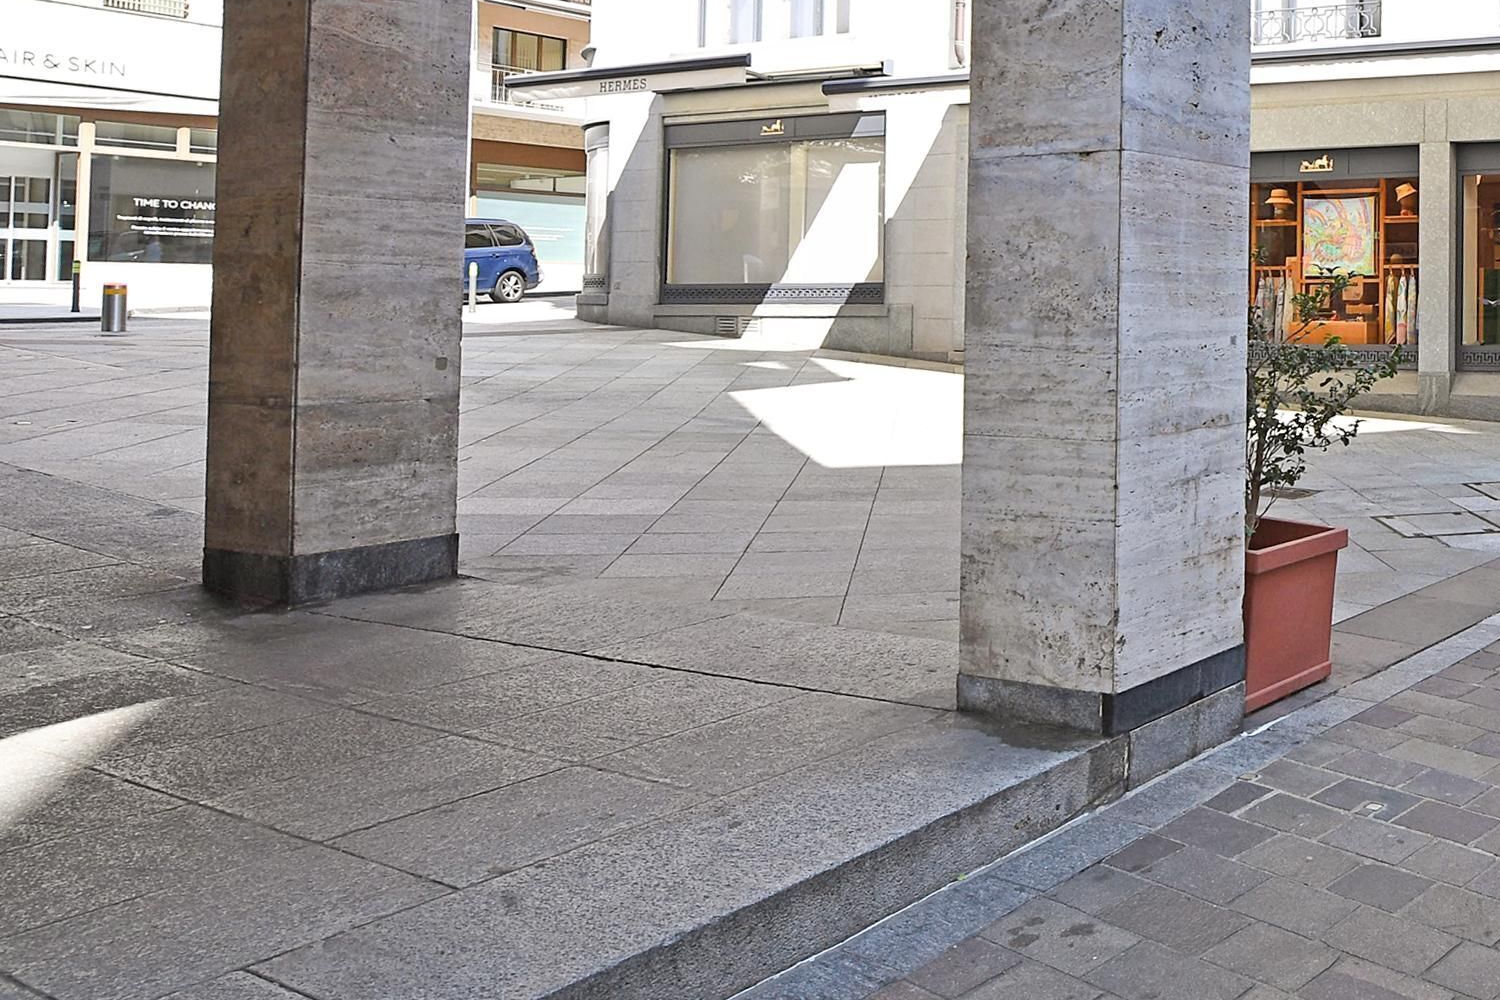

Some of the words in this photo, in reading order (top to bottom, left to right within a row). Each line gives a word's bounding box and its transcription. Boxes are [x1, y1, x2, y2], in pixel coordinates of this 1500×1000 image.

[43, 53, 61, 69] &
[68, 56, 126, 77] SKIN
[133, 198, 160, 208] TIME
[161, 199, 179, 209] TO
